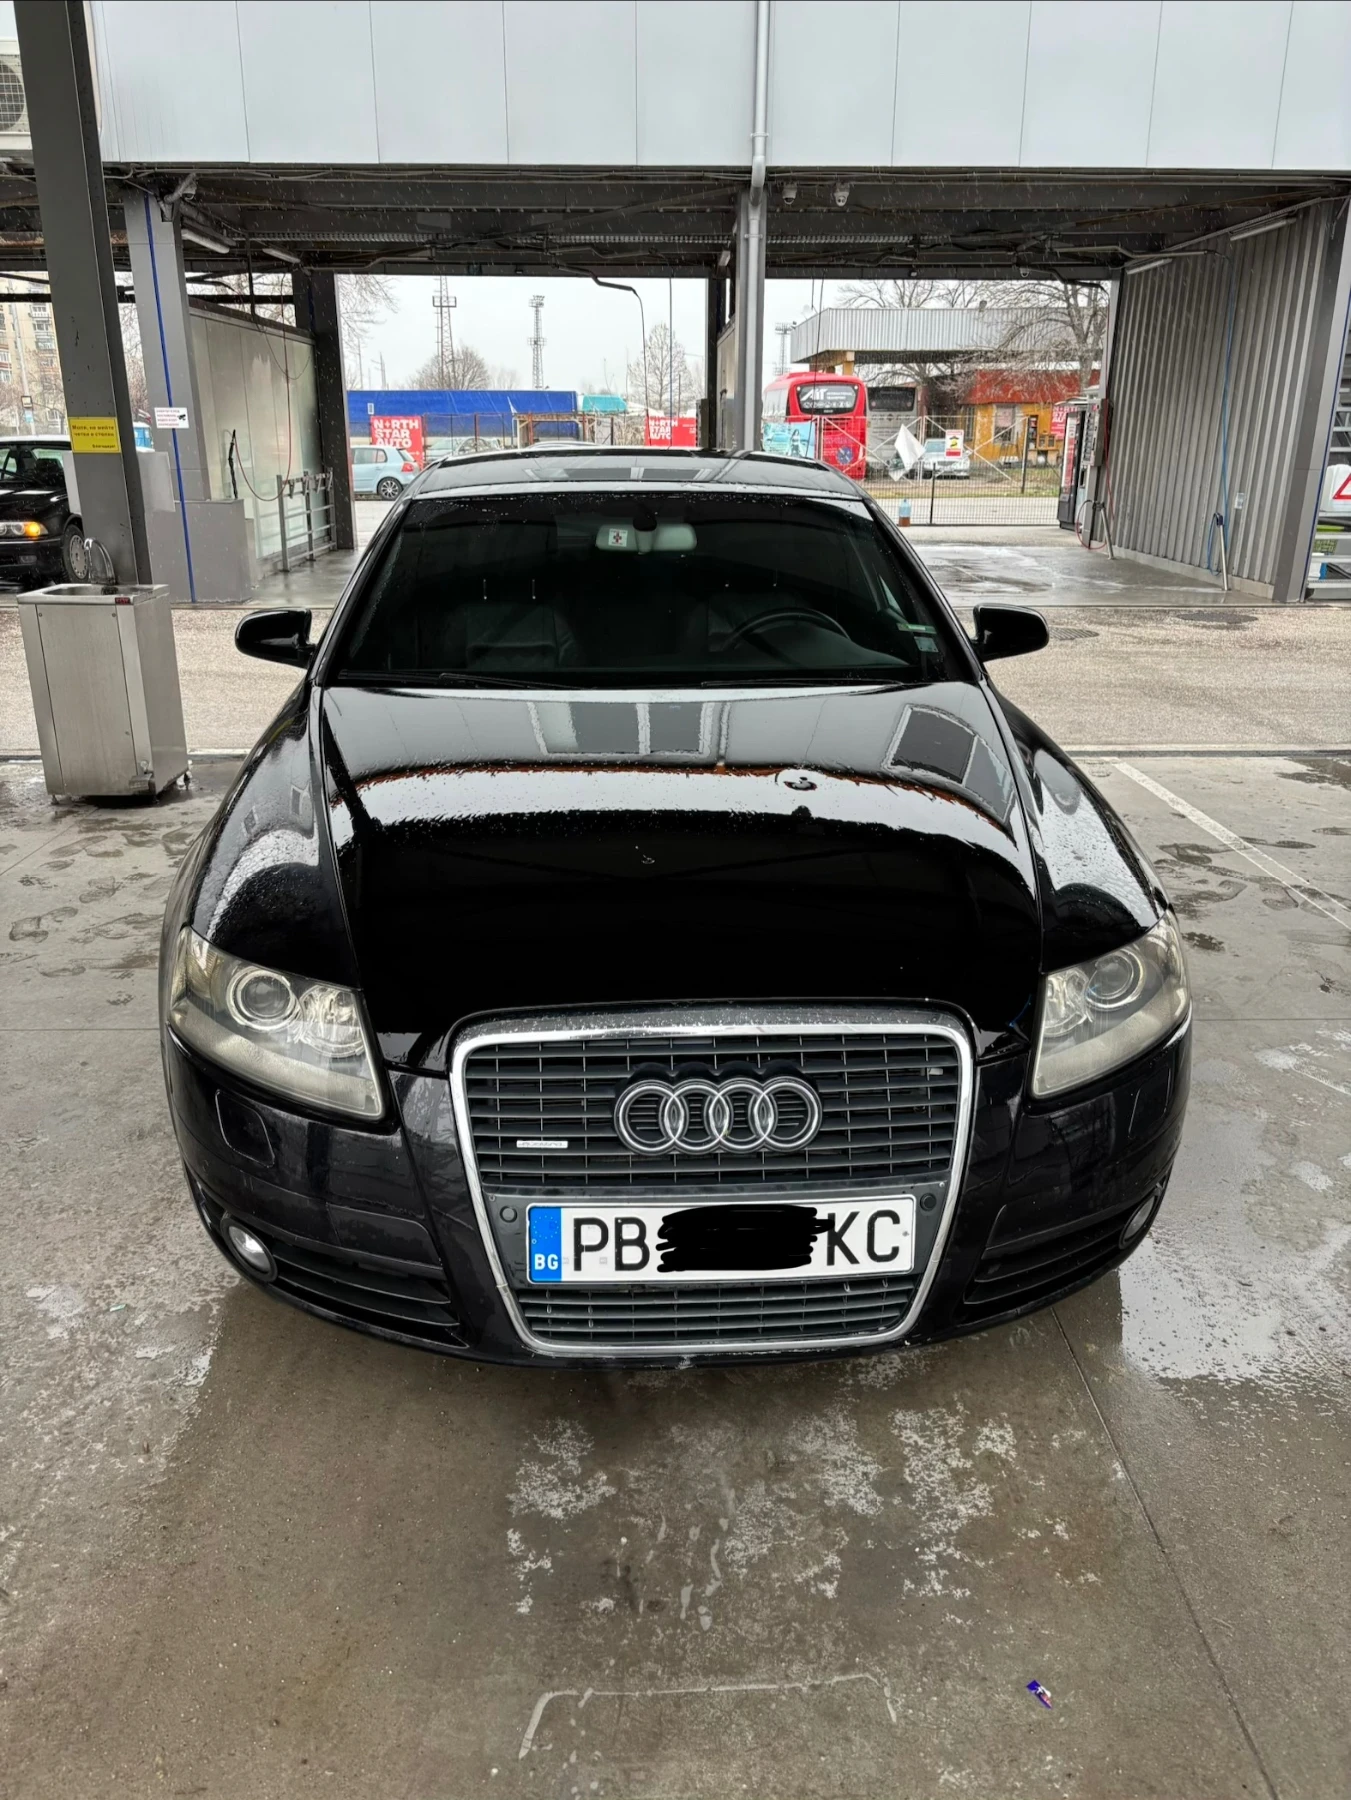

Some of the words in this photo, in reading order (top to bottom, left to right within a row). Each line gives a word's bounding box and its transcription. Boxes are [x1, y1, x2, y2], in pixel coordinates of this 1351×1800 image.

[375, 429, 410, 438] STAR
[376, 438, 412, 448] AUTO
[573, 1216, 650, 1272] PB
[826, 1209, 901, 1267] KC
[534, 1253, 559, 1271] BG
